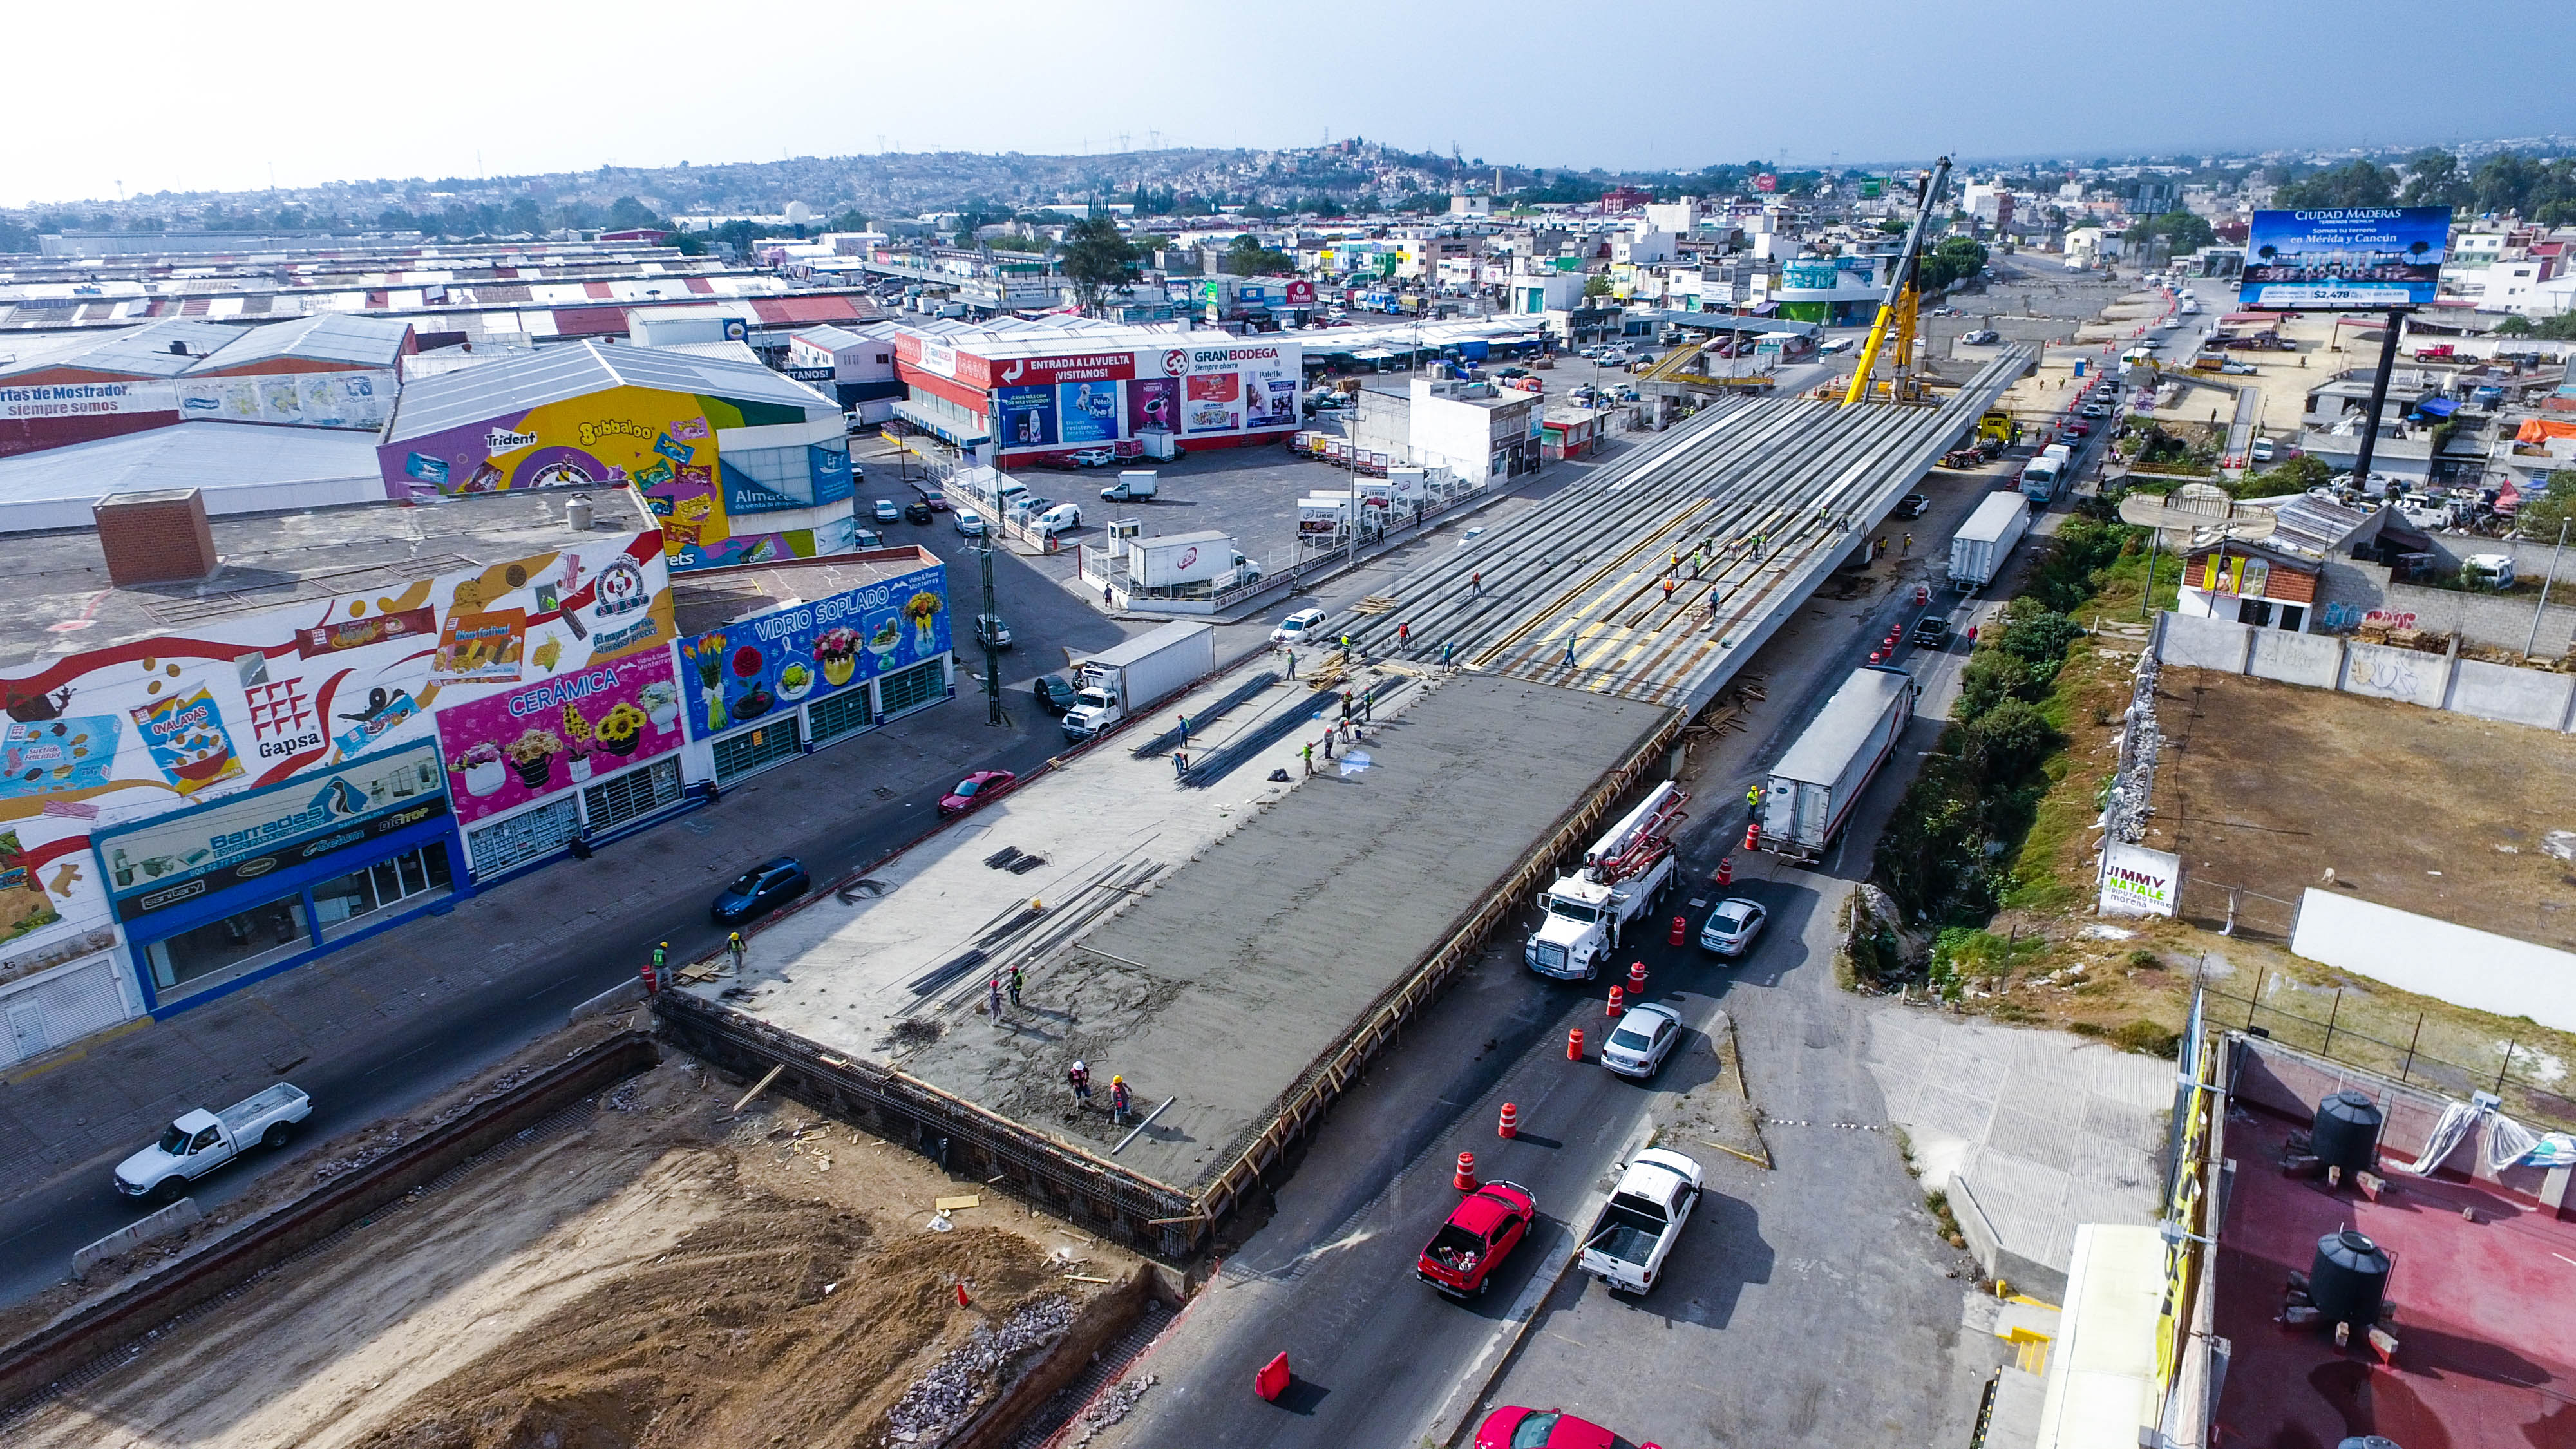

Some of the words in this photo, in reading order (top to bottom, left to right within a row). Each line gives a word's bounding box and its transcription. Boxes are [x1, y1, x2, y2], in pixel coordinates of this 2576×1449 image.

[2295, 211, 2343, 220] CIUDAD
[2347, 209, 2402, 219] MADERAS
[2306, 234, 2344, 243] Mérida
[2355, 233, 2397, 243] Cancún
[2314, 290, 2349, 299] $2,478
[1031, 359, 1075, 370] ENTRADA
[1077, 358, 1083, 367] A
[1084, 357, 1097, 367] LA
[1097, 355, 1130, 366] VUELTA
[1195, 350, 1227, 362] GRAN
[1229, 348, 1278, 360] BODEGA
[1195, 363, 1218, 372] Siempre
[33, 385, 50, 400] de
[8, 402, 68, 416] siempre
[71, 400, 118, 413] somos
[486, 432, 536, 446] Trident
[580, 419, 652, 445] Bubbaloo
[1358, 534, 1378, 547] PUBLIC
[909, 578, 939, 591] Monterrey
[1237, 590, 1248, 599] POR
[1249, 586, 1256, 595] LA
[599, 596, 646, 617] SUSY
[755, 610, 812, 641] VIDRIO
[815, 586, 889, 624] SOPLADO
[604, 629, 629, 643] mayor
[629, 618, 656, 633] surtido
[605, 638, 630, 653] menor
[631, 627, 658, 645] precio!
[638, 657, 672, 670] Monterrey
[509, 668, 620, 717] CERÁMICA
[153, 707, 207, 734] OVALADAS
[30, 745, 60, 755] Surtido
[259, 733, 321, 759] Gapsa
[24, 752, 61, 761] Felicidad
[338, 810, 385, 829] barradas.mx
[211, 805, 325, 850] Barradas
[215, 842, 248, 858] EQUIPO
[251, 835, 273, 847] PARA
[276, 819, 325, 839] COMERCIOS
[190, 867, 205, 876] 800
[2107, 866, 2166, 888] JIMMY
[146, 882, 202, 907] sanitary
[2110, 877, 2166, 900] NATALE
[2112, 888, 2147, 902] DIPUTADO
[2111, 894, 2147, 908] morena
